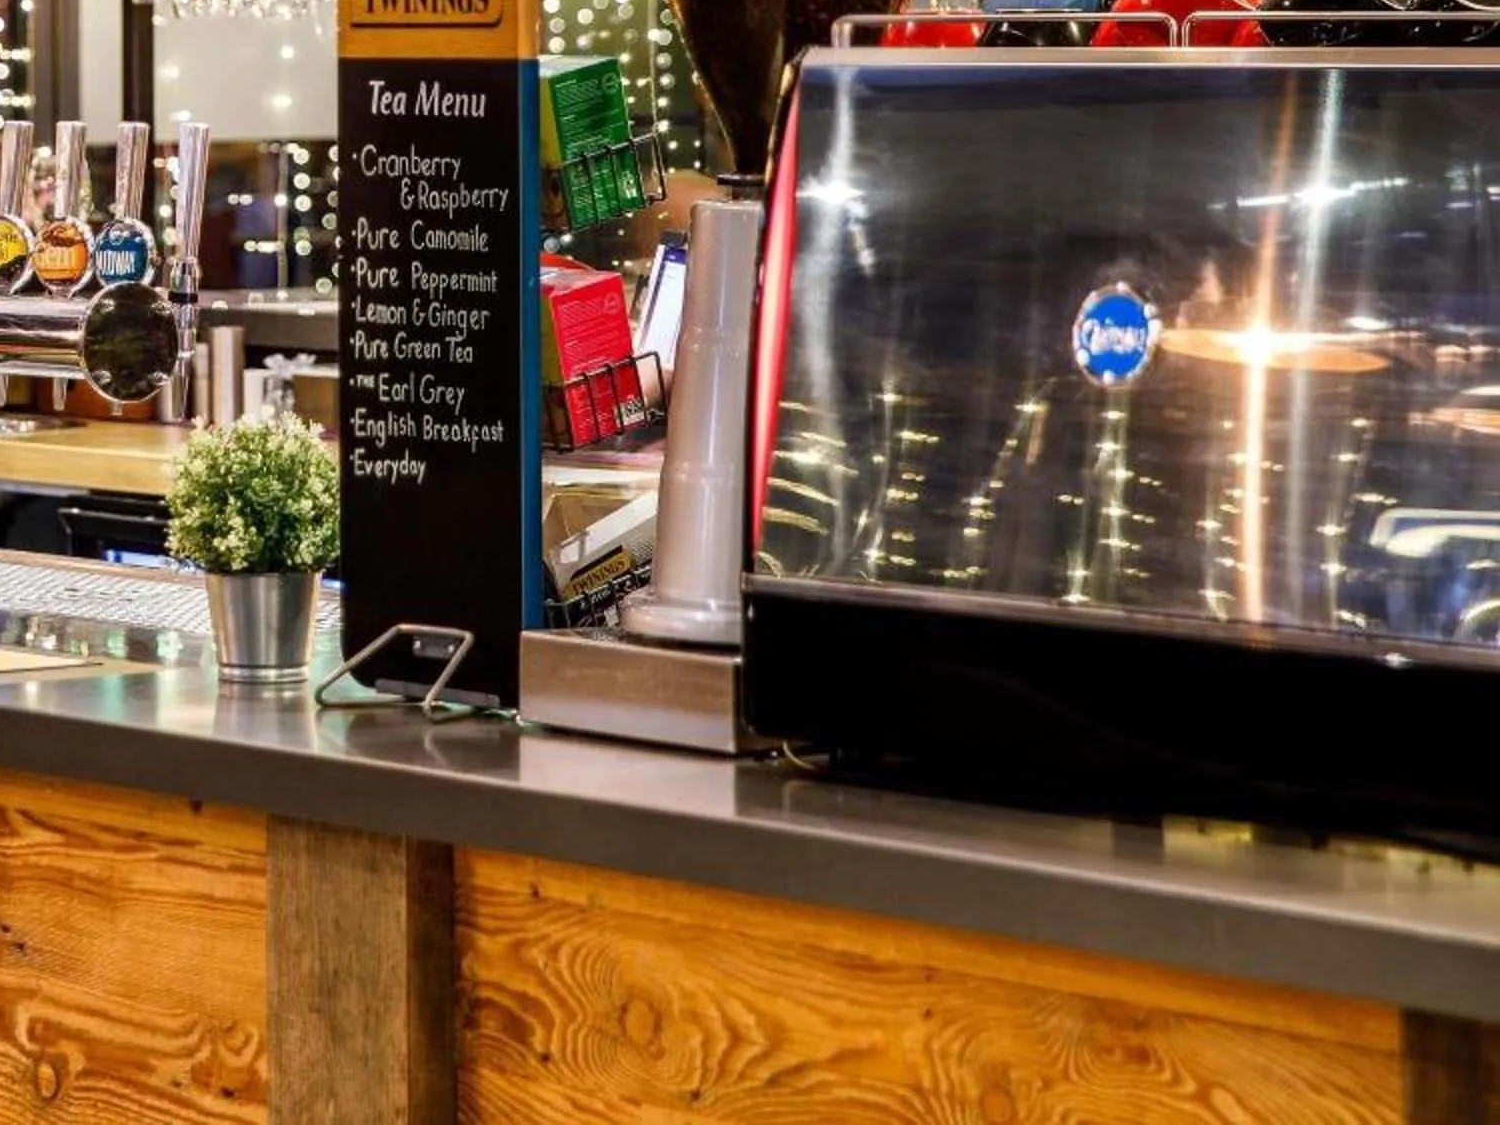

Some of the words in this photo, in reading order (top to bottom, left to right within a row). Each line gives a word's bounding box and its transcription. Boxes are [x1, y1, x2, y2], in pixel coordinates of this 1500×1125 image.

[369, 79, 407, 115] Tea
[415, 79, 487, 117] Menu
[360, 143, 461, 180] Cranberry
[417, 180, 509, 219] Raspberry
[357, 217, 400, 250] Pure
[411, 219, 489, 252] Camomile
[356, 256, 400, 288] Pure
[411, 261, 498, 300] Peppermint
[355, 295, 407, 325] Lemon
[412, 298, 426, 326] &
[428, 301, 491, 339] Ginger
[354, 330, 389, 359] Pure
[394, 331, 441, 359] Green
[445, 335, 474, 363] Tea
[355, 374, 376, 388] THE
[379, 372, 415, 403] Earl
[419, 374, 466, 416] Grey
[354, 408, 417, 448] English
[423, 415, 504, 453] Breakfast
[354, 448, 427, 484] Everyday
[571, 559, 626, 596] TWININGS
